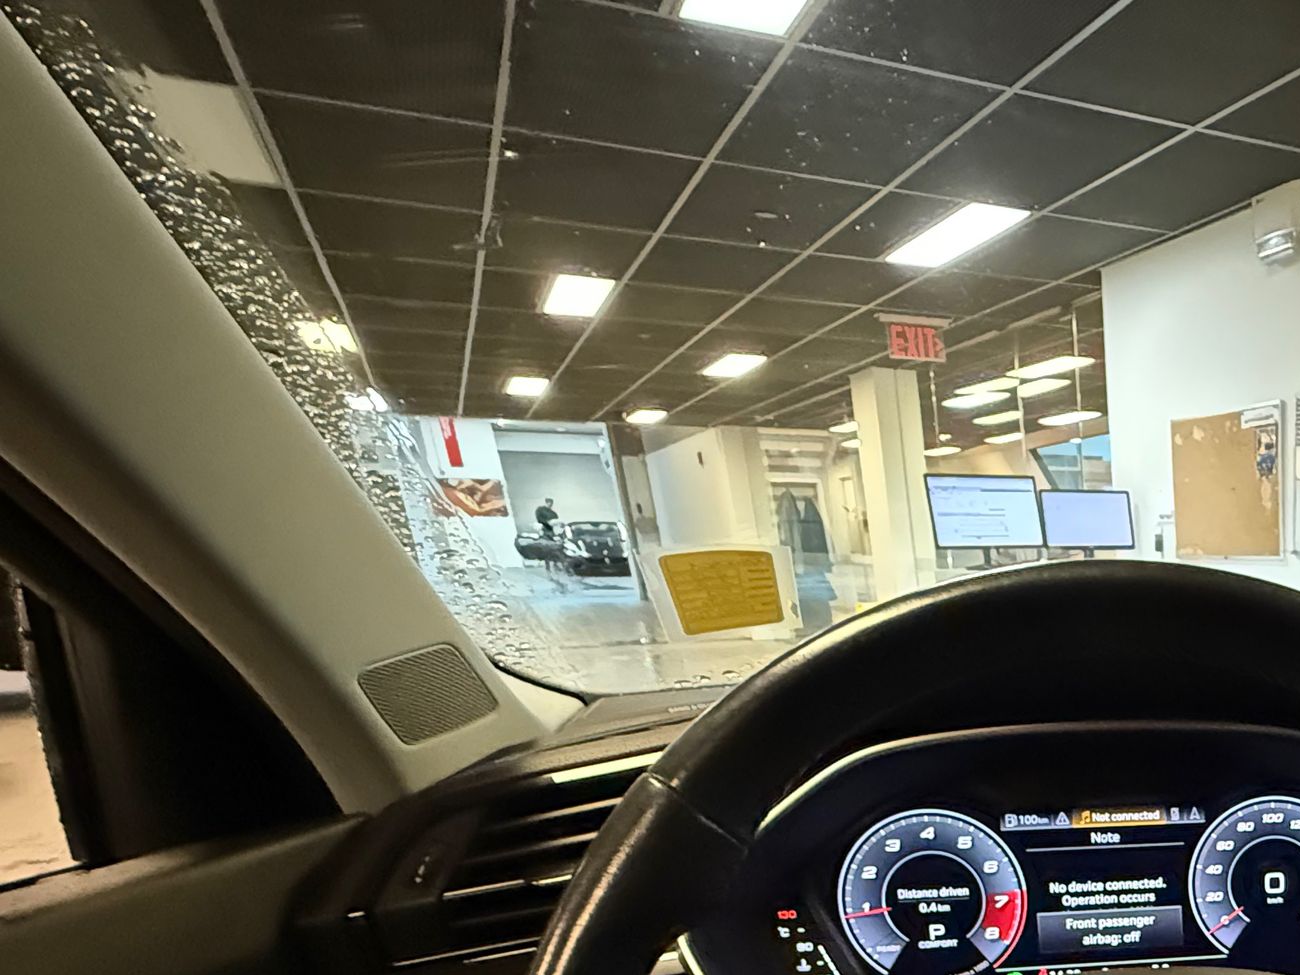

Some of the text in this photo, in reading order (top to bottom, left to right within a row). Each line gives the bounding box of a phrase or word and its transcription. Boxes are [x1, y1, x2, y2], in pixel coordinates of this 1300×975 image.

[890, 324, 936, 358] EXIT
[1092, 810, 1160, 823] Not connected
[1262, 813, 1284, 824] 100
[1236, 821, 1255, 832] 80
[920, 827, 935, 840] 4
[1090, 832, 1121, 844] Note
[885, 839, 901, 852] 3
[957, 836, 972, 849] 5
[861, 866, 877, 879] 2
[983, 860, 998, 873] 6
[1205, 865, 1222, 875] 40
[1049, 877, 1167, 894] No device connected.
[1264, 872, 1286, 894] 0
[897, 887, 970, 900] Distance driven
[1062, 892, 1156, 908] Operation occurs
[1206, 891, 1224, 902] 20
[862, 902, 871, 913] 1
[994, 896, 1009, 908] 7
[1066, 915, 1156, 931] Front passenger
[929, 924, 945, 940] P
[985, 927, 1000, 940] 8
[1082, 931, 1142, 946] airbag: off
[918, 939, 958, 949] COMFORT
